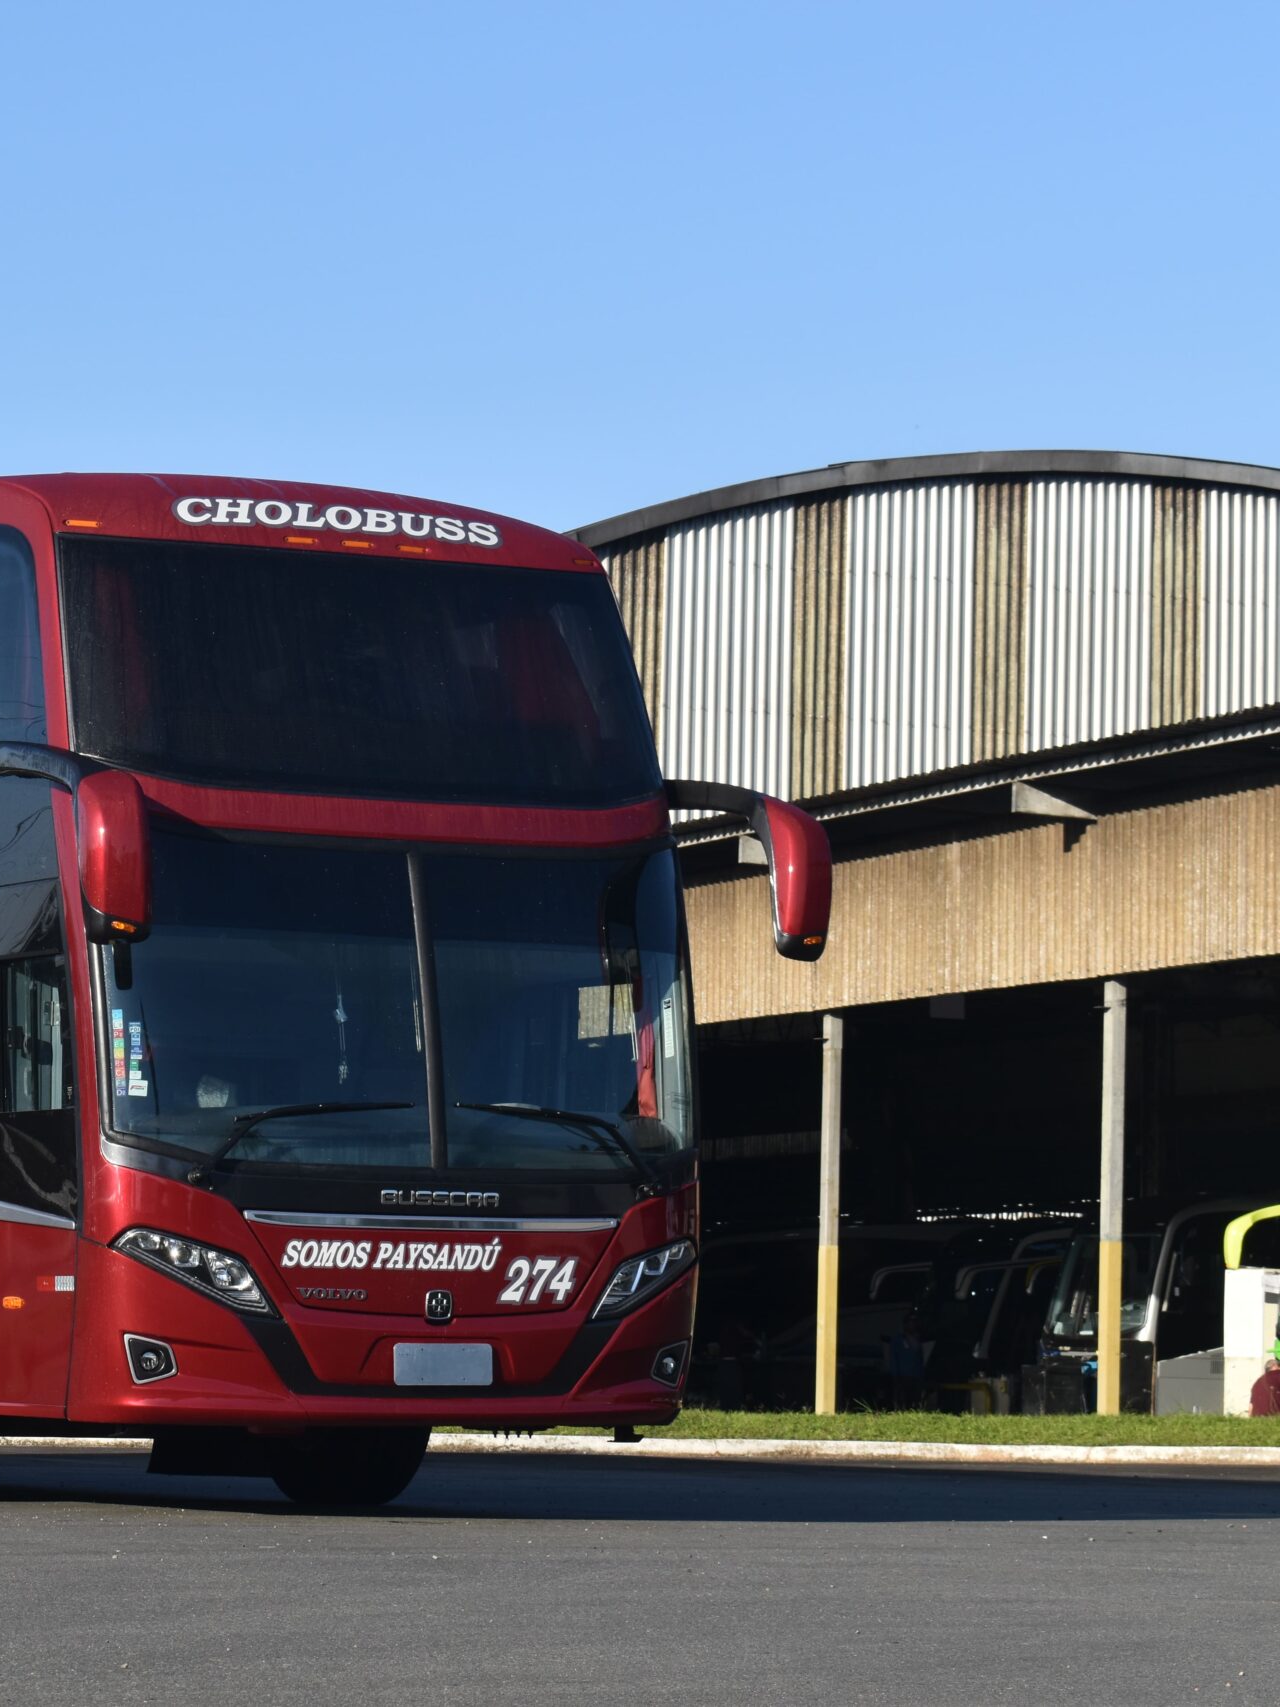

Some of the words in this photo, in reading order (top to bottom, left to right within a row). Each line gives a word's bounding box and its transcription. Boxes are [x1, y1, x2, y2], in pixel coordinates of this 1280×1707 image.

[176, 497, 500, 546] CHOLOBUSS
[380, 1189, 500, 1208] BUSSCAR
[281, 1239, 372, 1269] SOMOS
[373, 1237, 502, 1271] PAYSANDÚ
[296, 1287, 369, 1301] VOLVO
[500, 1256, 576, 1303] 274
